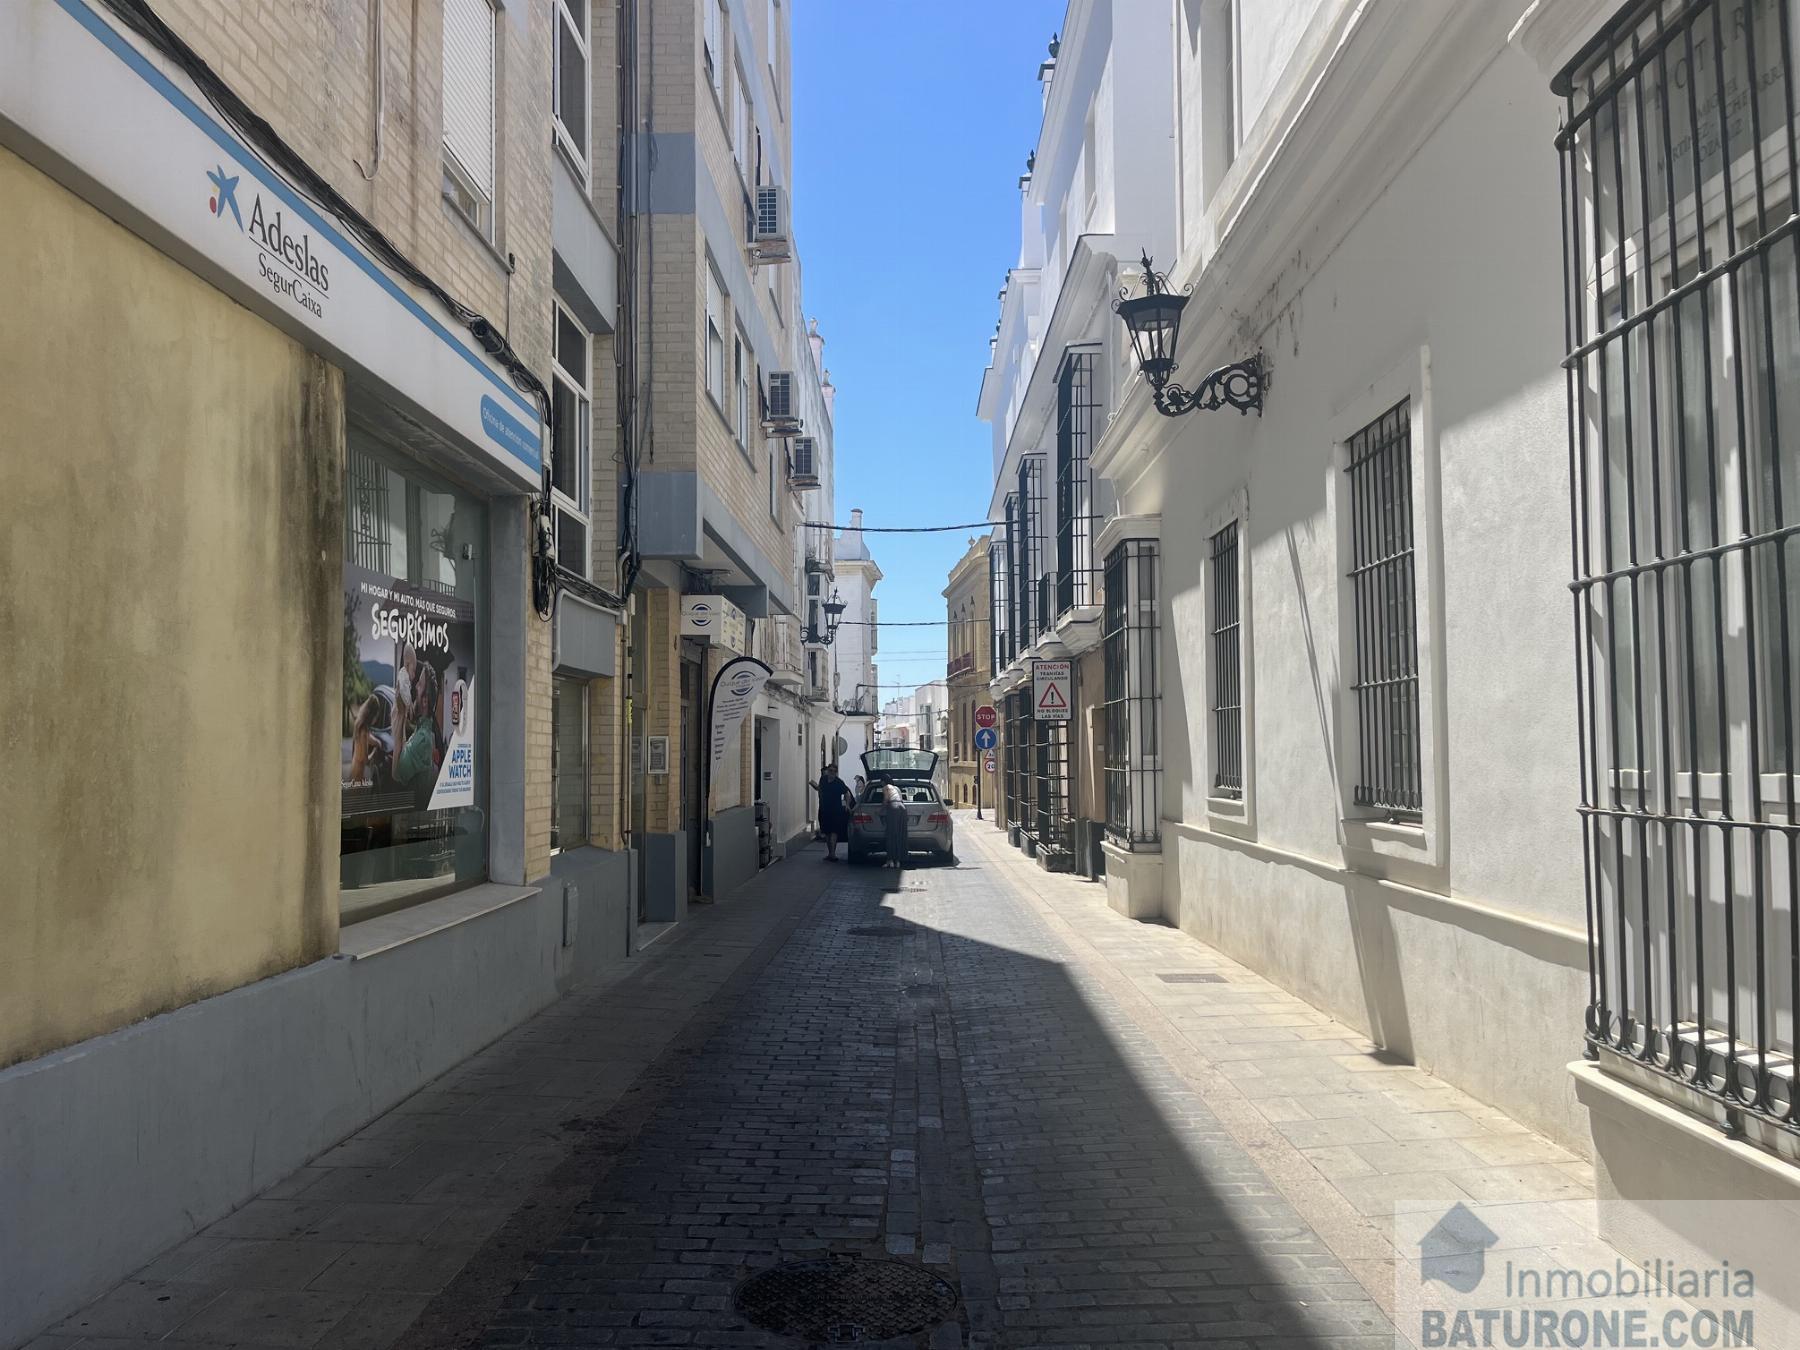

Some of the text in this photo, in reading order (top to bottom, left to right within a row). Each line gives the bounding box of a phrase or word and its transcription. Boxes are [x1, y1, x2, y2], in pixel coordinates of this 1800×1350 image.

[249, 193, 329, 291] Adeslas
[259, 252, 322, 318] SegurCaixa
[368, 584, 389, 599] HOGAR
[451, 749, 472, 763] APPLE
[448, 764, 472, 779] WATCH
